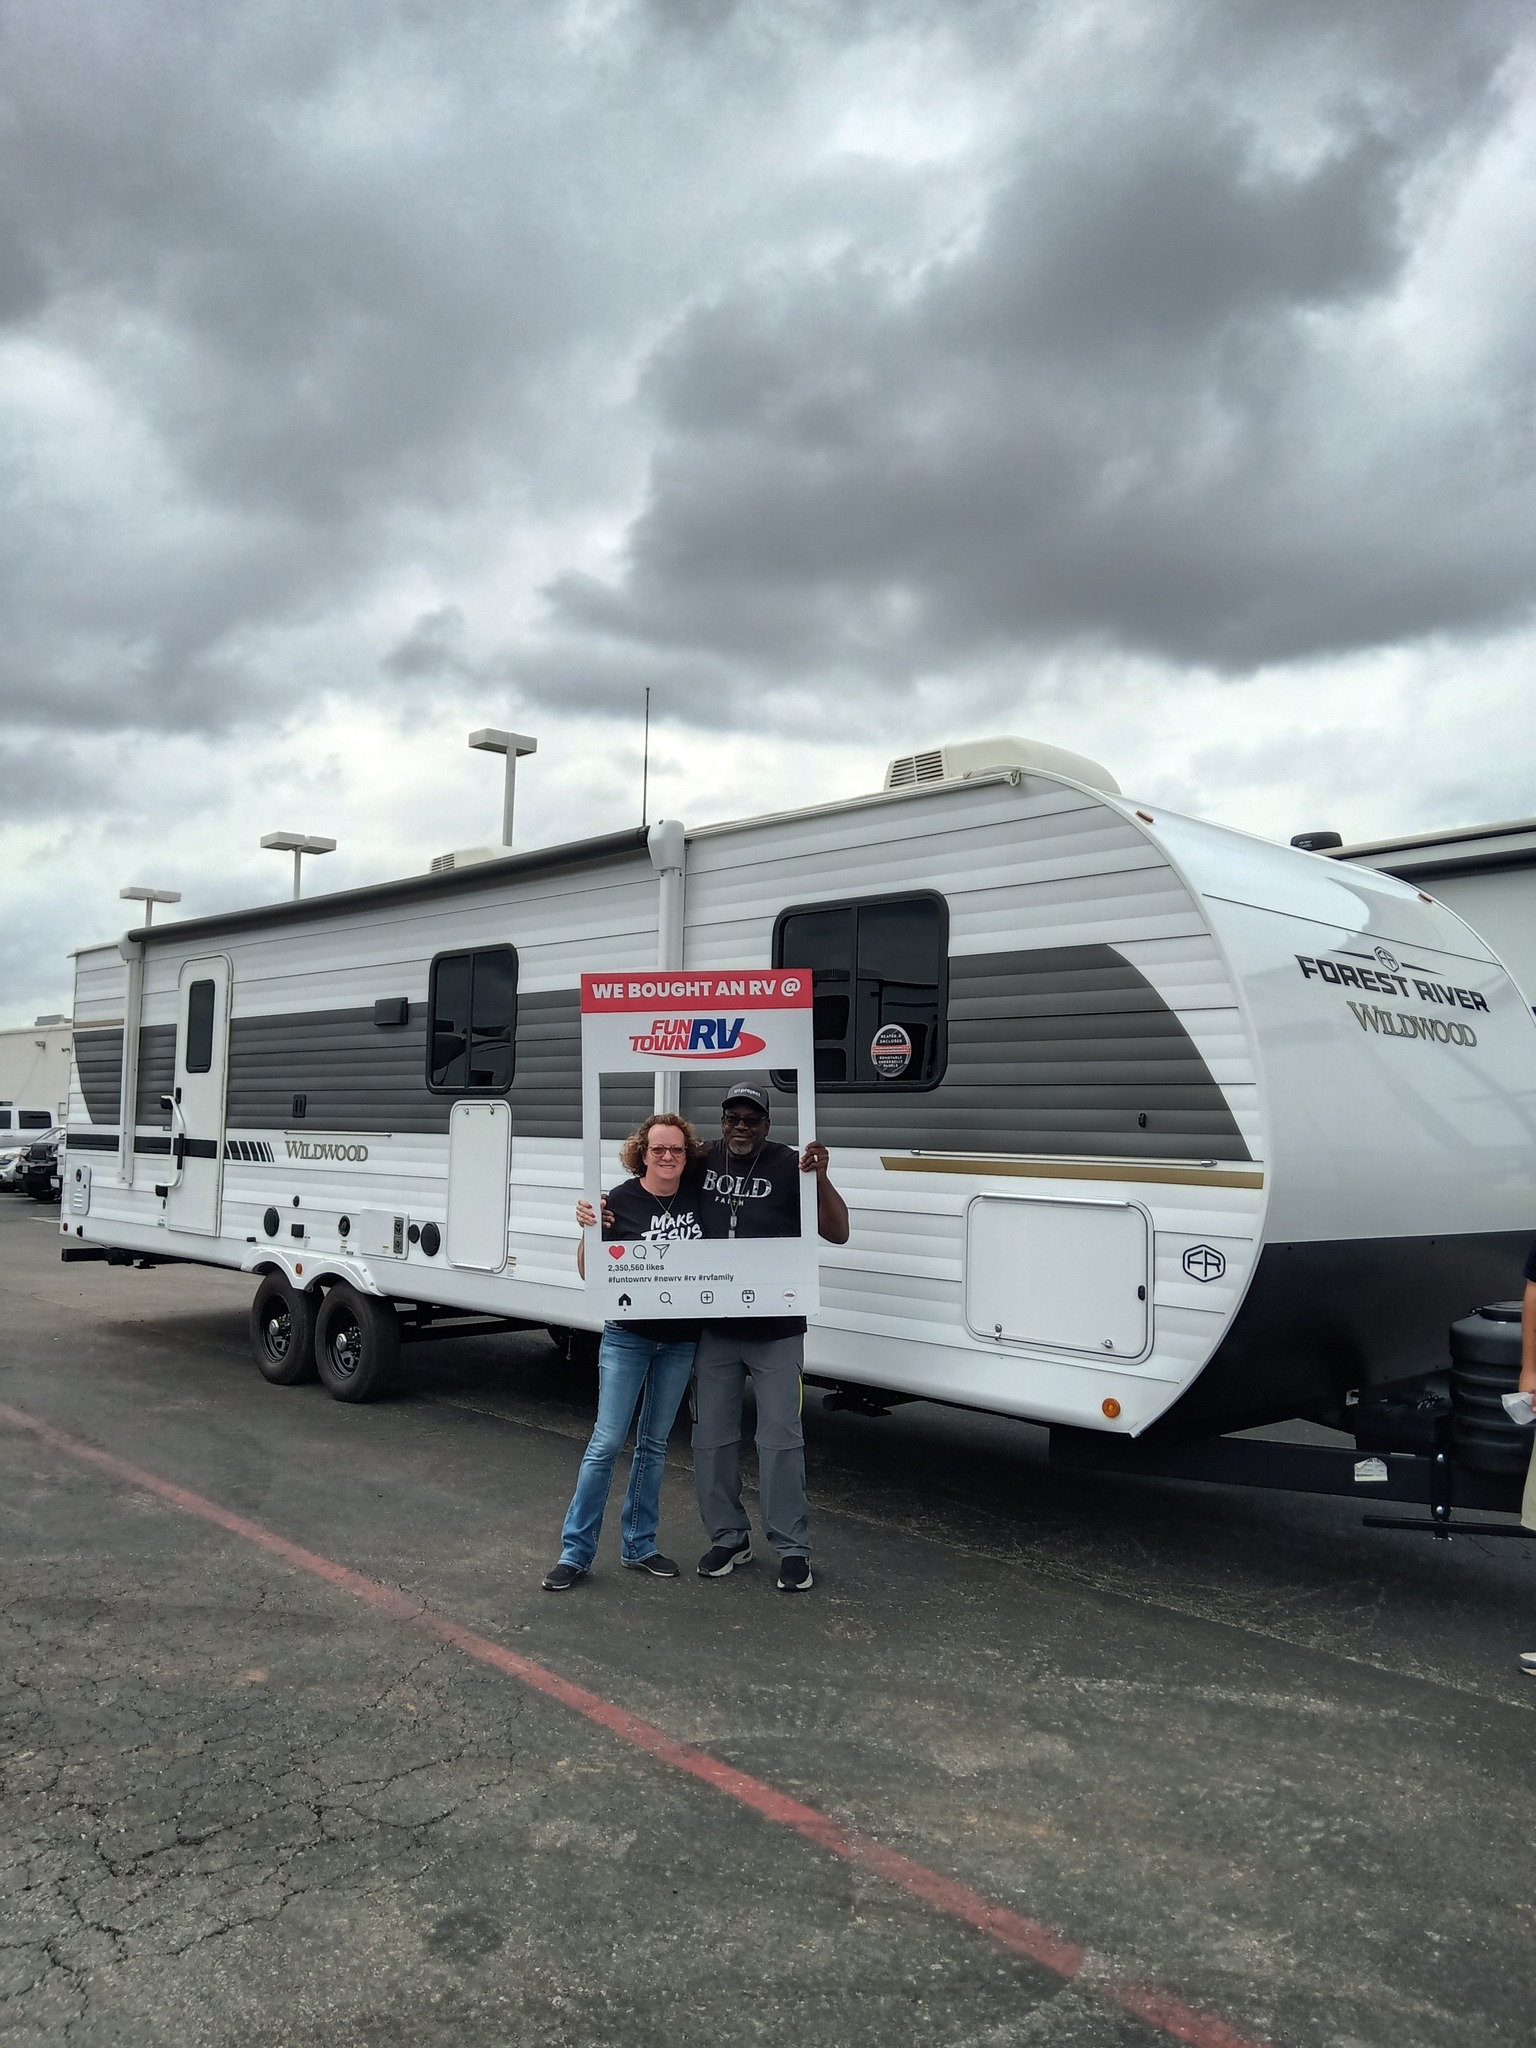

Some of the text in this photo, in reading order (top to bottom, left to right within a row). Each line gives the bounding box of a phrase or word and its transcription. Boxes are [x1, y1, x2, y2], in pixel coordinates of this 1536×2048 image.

[592, 977, 802, 999] WE BOUGHT AN RV @
[1294, 954, 1491, 1013] FOREST RIVER
[650, 1018, 745, 1050] FUN RV
[1346, 1000, 1478, 1047] WILDWOOD
[628, 1035, 690, 1051] TOWN
[284, 1140, 369, 1162] WILDWOOD
[702, 1169, 773, 1198] BOLD
[650, 1211, 695, 1232] MAKE
[607, 1263, 665, 1272] 2,350,560 likes
[608, 1275, 652, 1283] #funtownrv
[698, 1273, 734, 1282] #rvfamily
